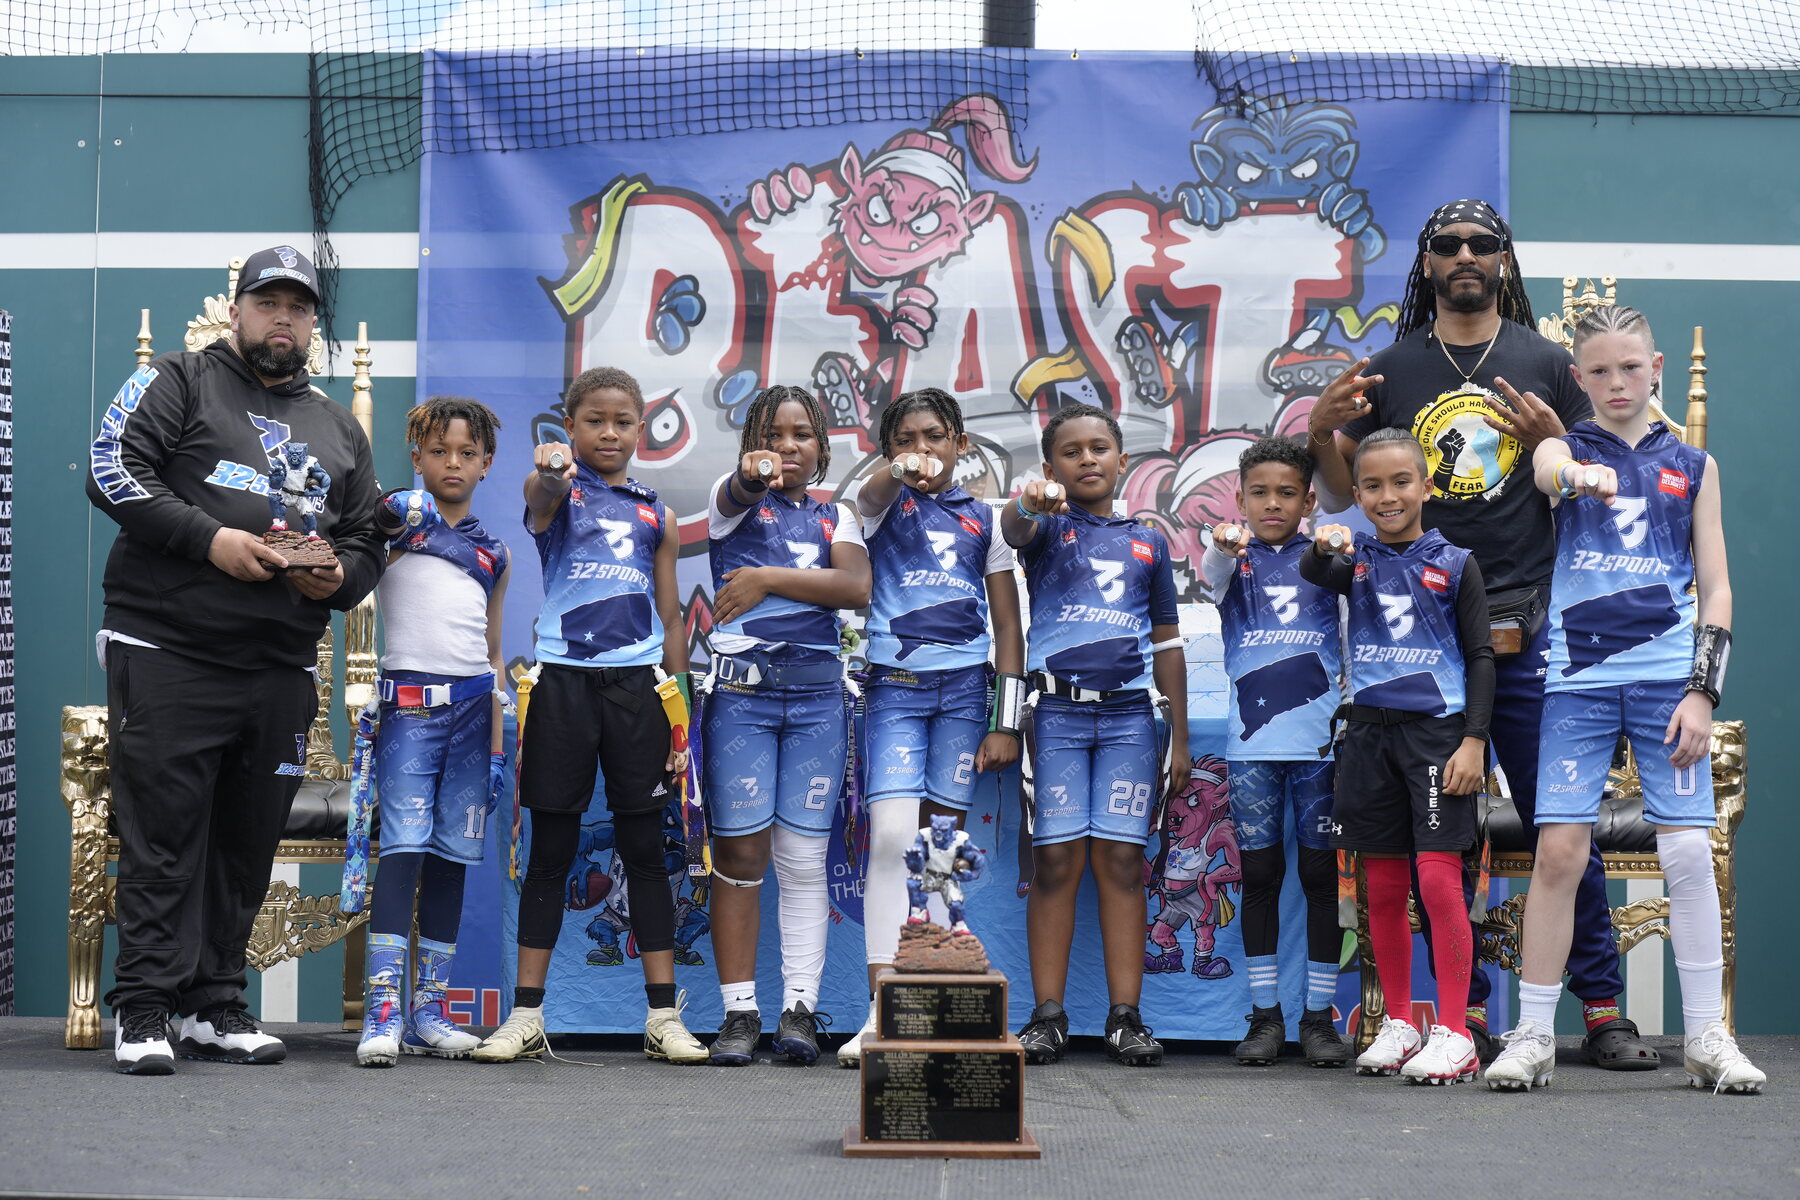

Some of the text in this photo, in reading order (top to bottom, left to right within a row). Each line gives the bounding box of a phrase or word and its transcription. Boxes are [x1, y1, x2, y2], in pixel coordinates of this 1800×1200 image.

[1423, 425, 1434, 444] ONE
[1431, 401, 1465, 424] SHOULD
[1452, 481, 1484, 490] FEAR
[1661, 478, 1685, 490] DELIGHTS
[1662, 472, 1685, 484] NATURAL
[952, 751, 975, 786] 2
[652, 789, 668, 798] adidas
[804, 775, 832, 811] 2
[1107, 778, 1151, 818] 28
[1428, 765, 1439, 808] RISE
[463, 803, 488, 839] 11
